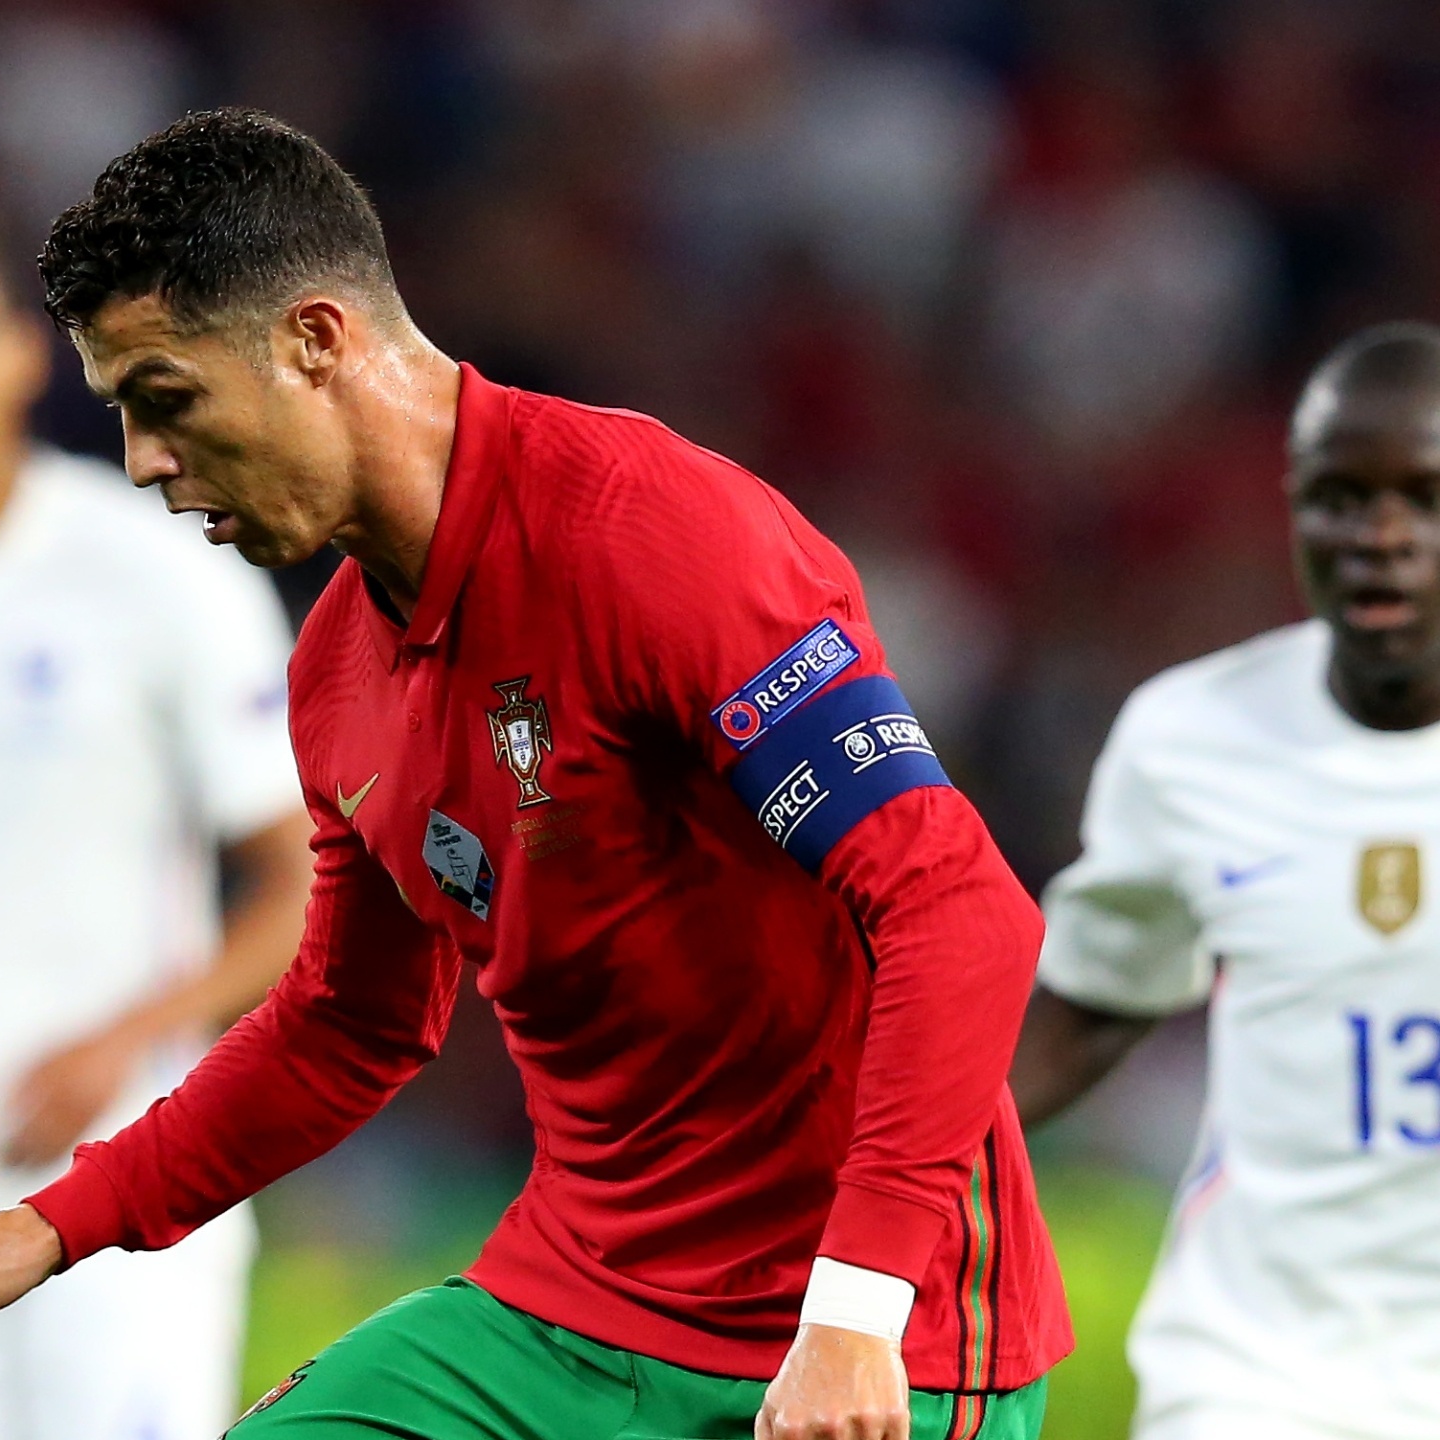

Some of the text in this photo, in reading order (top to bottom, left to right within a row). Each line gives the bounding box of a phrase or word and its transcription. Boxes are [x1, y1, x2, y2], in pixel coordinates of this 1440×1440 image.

[754, 629, 848, 713] RESPECT
[763, 768, 820, 843] SPECT
[1346, 1012, 1440, 1148] 13
